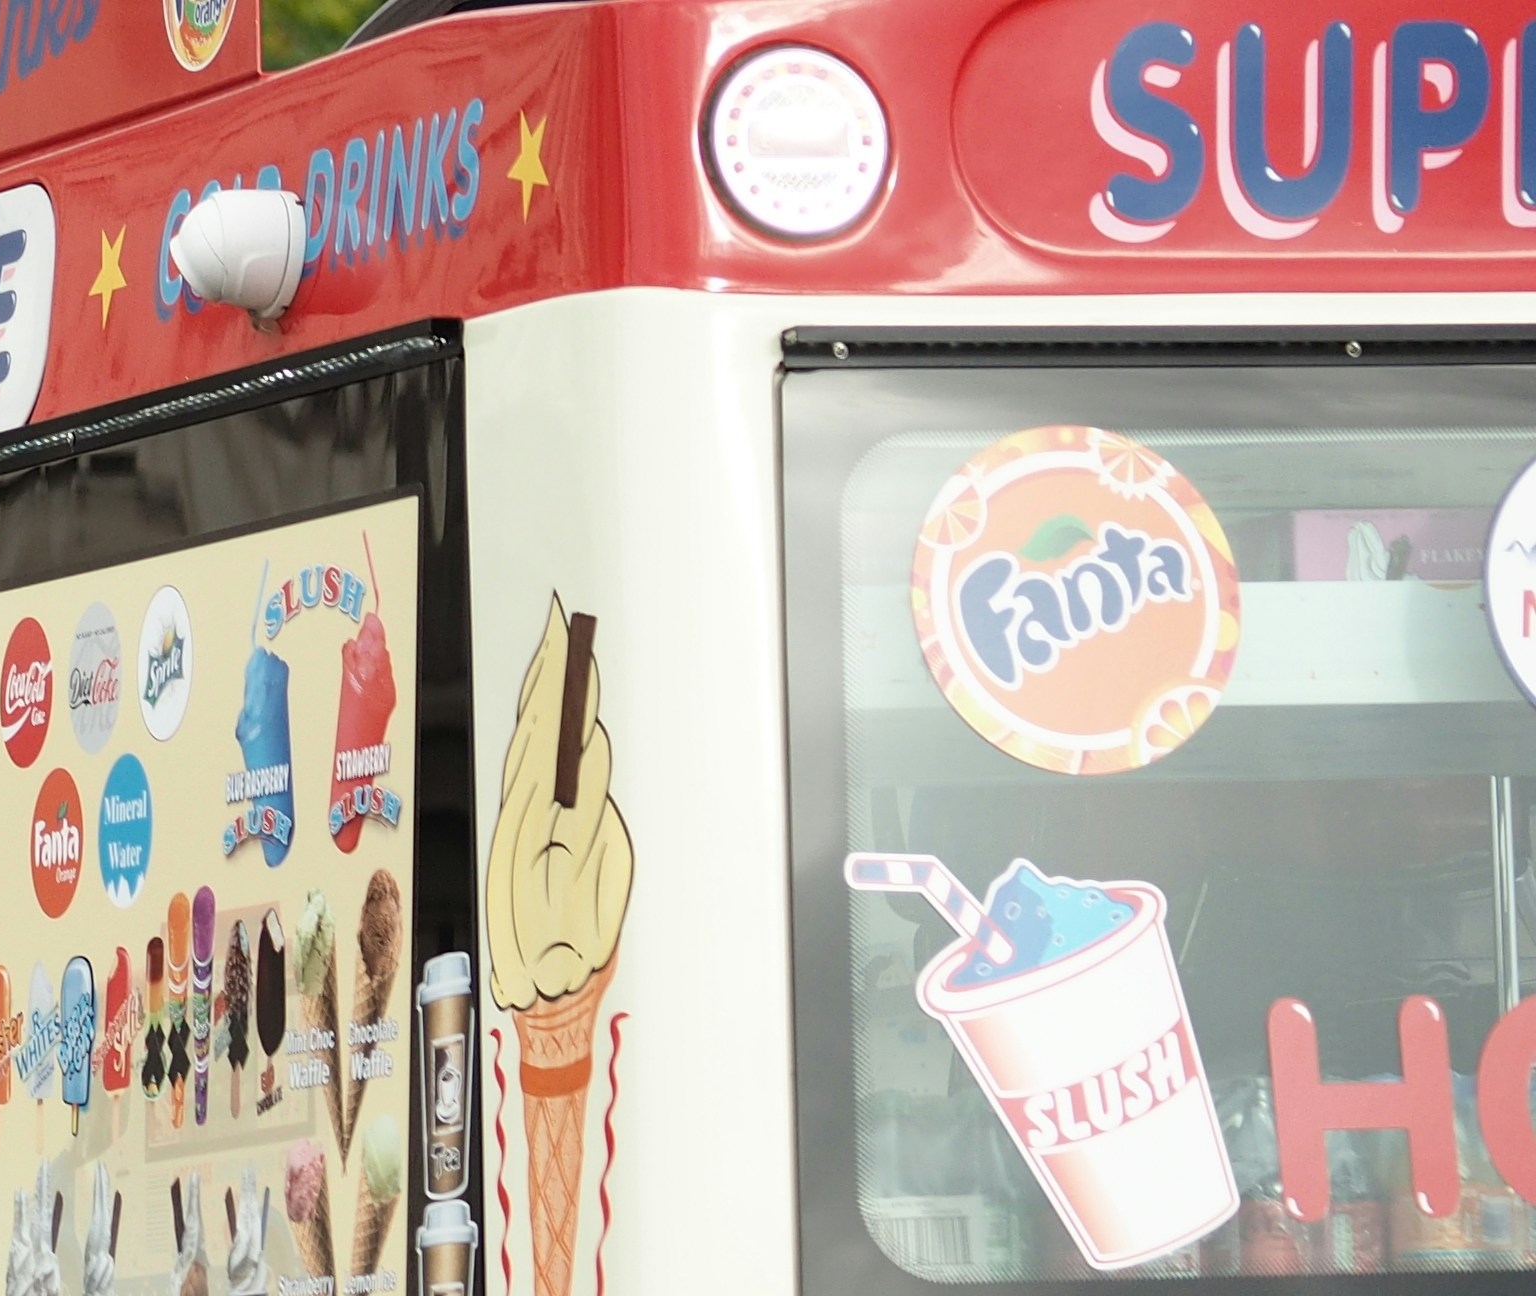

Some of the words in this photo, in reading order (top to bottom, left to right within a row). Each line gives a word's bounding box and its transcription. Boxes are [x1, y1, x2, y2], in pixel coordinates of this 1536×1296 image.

[1091, 20, 1536, 238] SUP
[298, 98, 485, 268] DRINKS
[1420, 549, 1485, 563] FLAKE
[264, 563, 367, 639] SLUSH
[958, 521, 1192, 690] Fanta
[6, 660, 52, 714] Coca-Cola
[69, 668, 93, 709] Diet
[92, 657, 119, 704] Coke
[148, 646, 181, 697] Sprite
[226, 771, 245, 804] BLUE
[245, 764, 289, 799] RASPBERRY
[336, 743, 390, 781] STRAWBERRY
[104, 790, 147, 824] Mineral
[222, 805, 292, 856] SLUSH
[329, 784, 401, 835] SLUSH
[35, 818, 79, 868] Fanta
[108, 841, 142, 869] Water
[56, 868, 77, 884] Orange
[15, 1012, 61, 1080] WHITES
[310, 1026, 335, 1052] Choc
[348, 1017, 399, 1046] Chocolate
[290, 1058, 330, 1090] Waffle
[351, 1048, 393, 1081] Waffle
[1022, 1031, 1189, 1149] SLUSH
[431, 1142, 462, 1181] Tea
